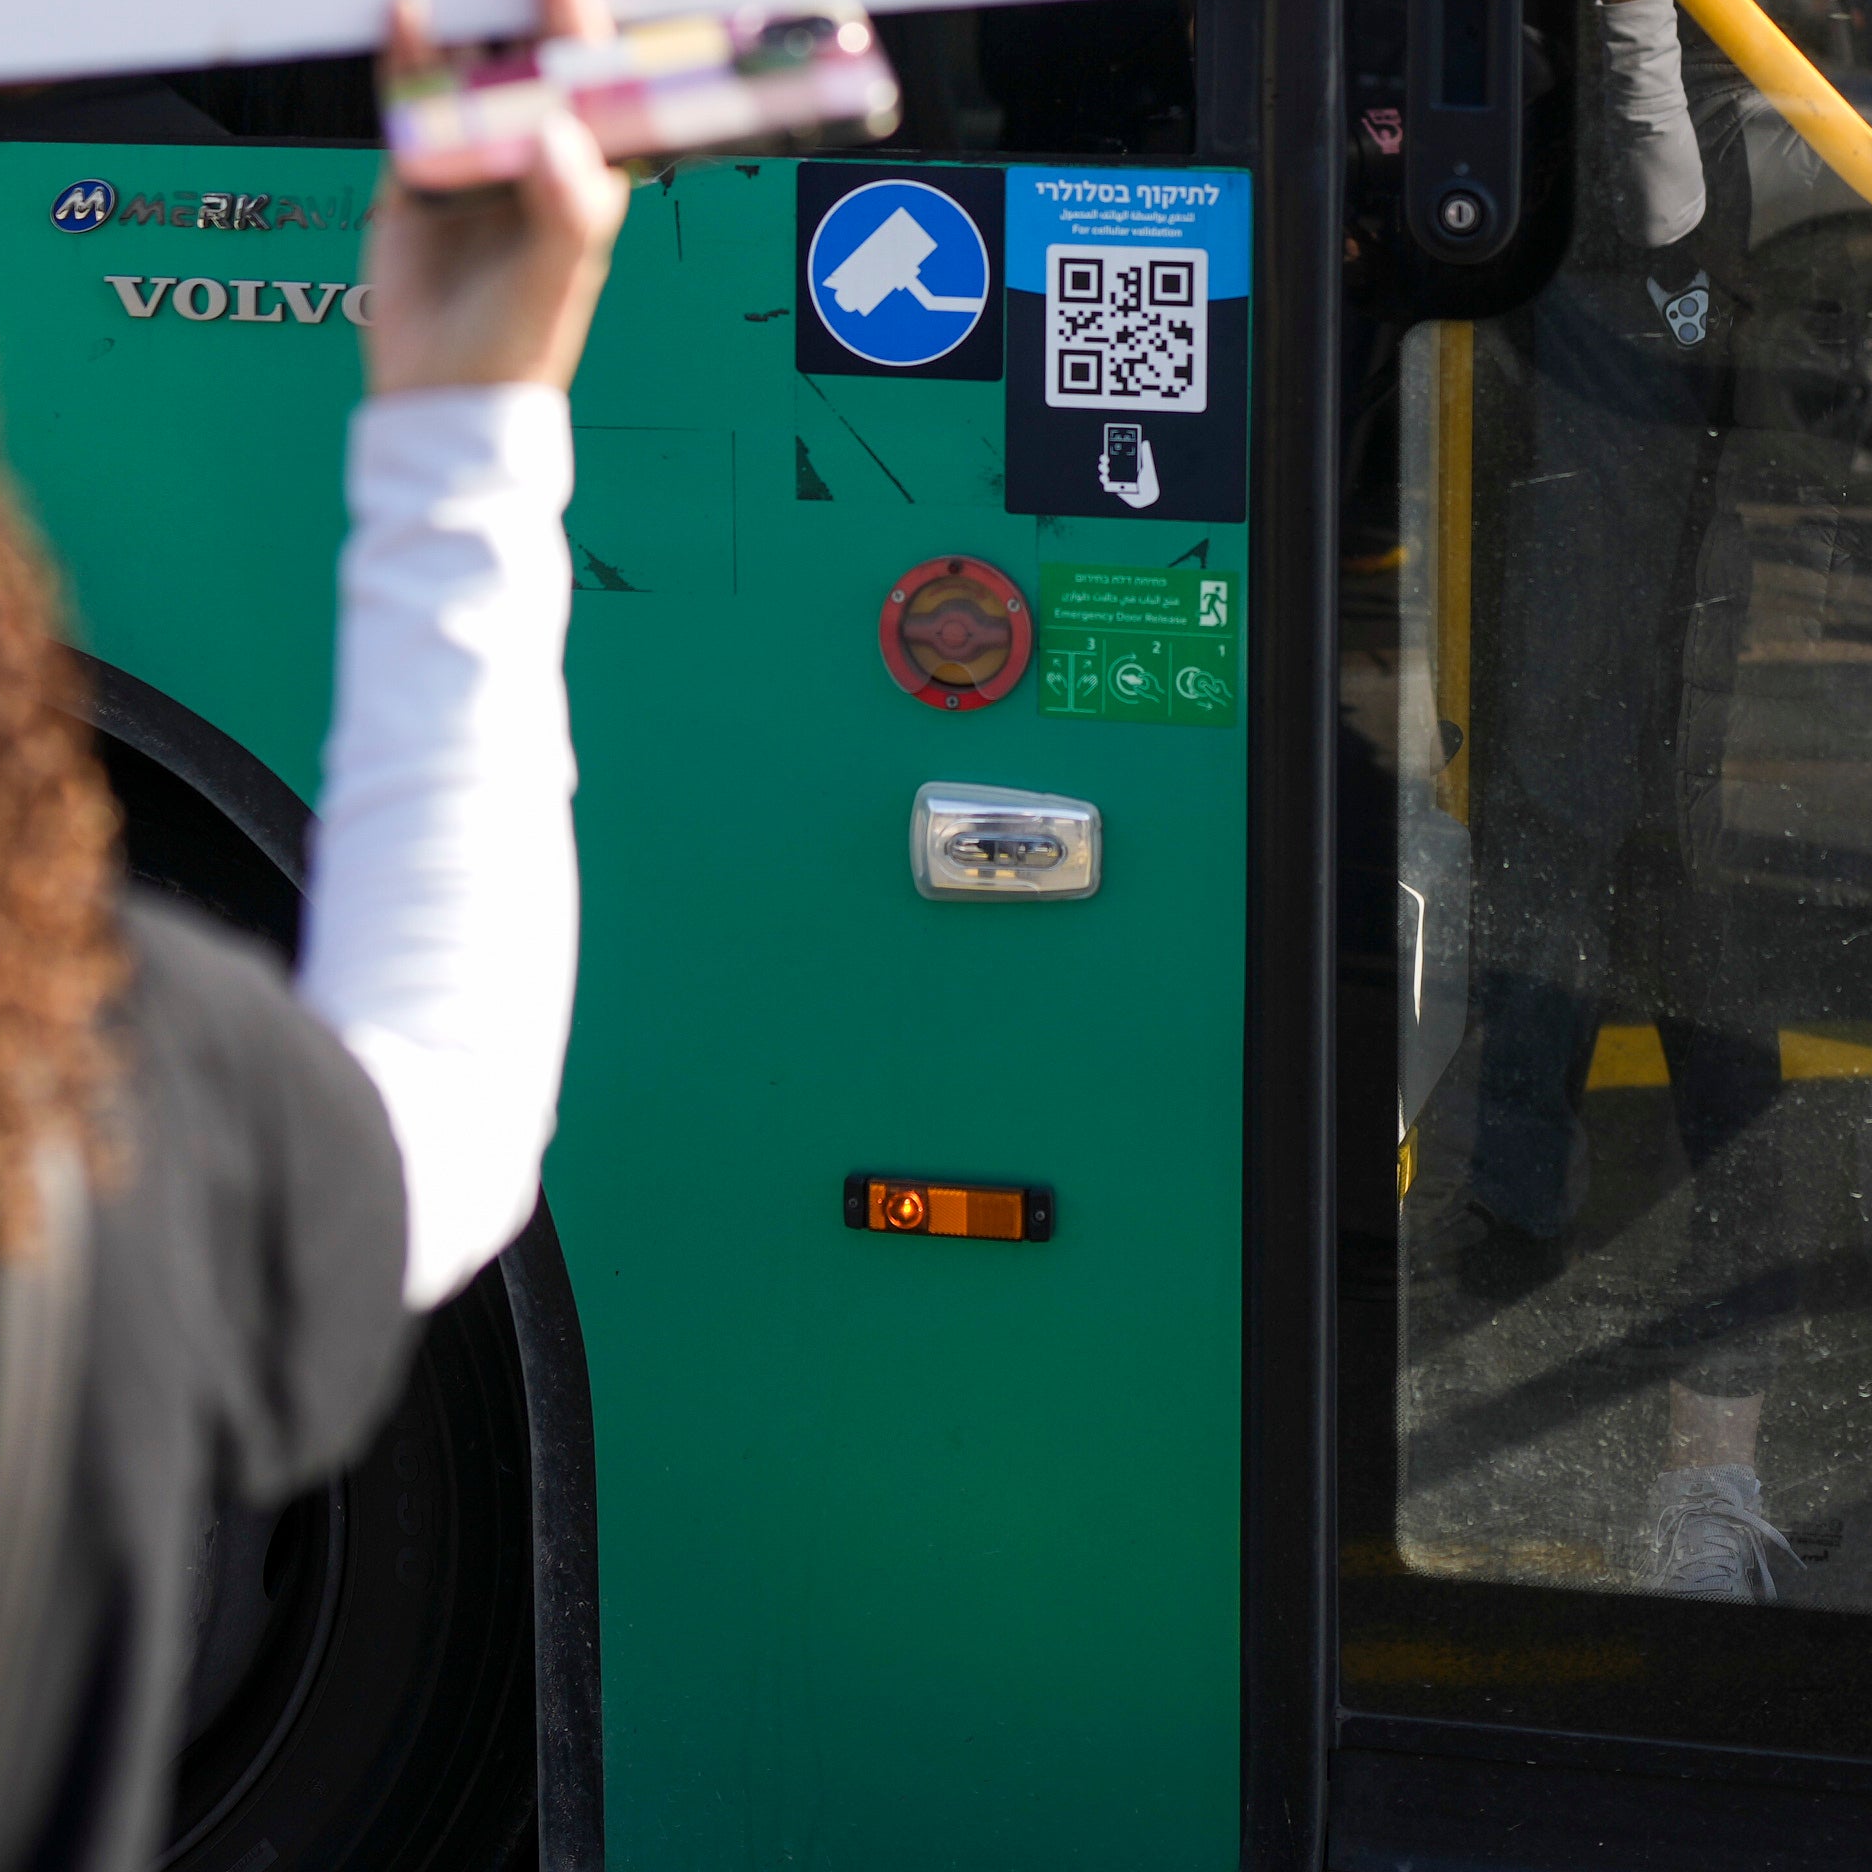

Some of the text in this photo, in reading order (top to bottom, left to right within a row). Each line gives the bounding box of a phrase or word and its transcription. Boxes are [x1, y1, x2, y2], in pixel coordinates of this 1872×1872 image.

[1035, 178, 1221, 210] לתיקוף בסלולרי
[1071, 223, 1183, 238] For cellular validation
[1054, 607, 1189, 626] Emergency Door Release
[1086, 637, 1096, 651] 3
[1152, 640, 1162, 654] 2
[1218, 644, 1226, 658] 1
